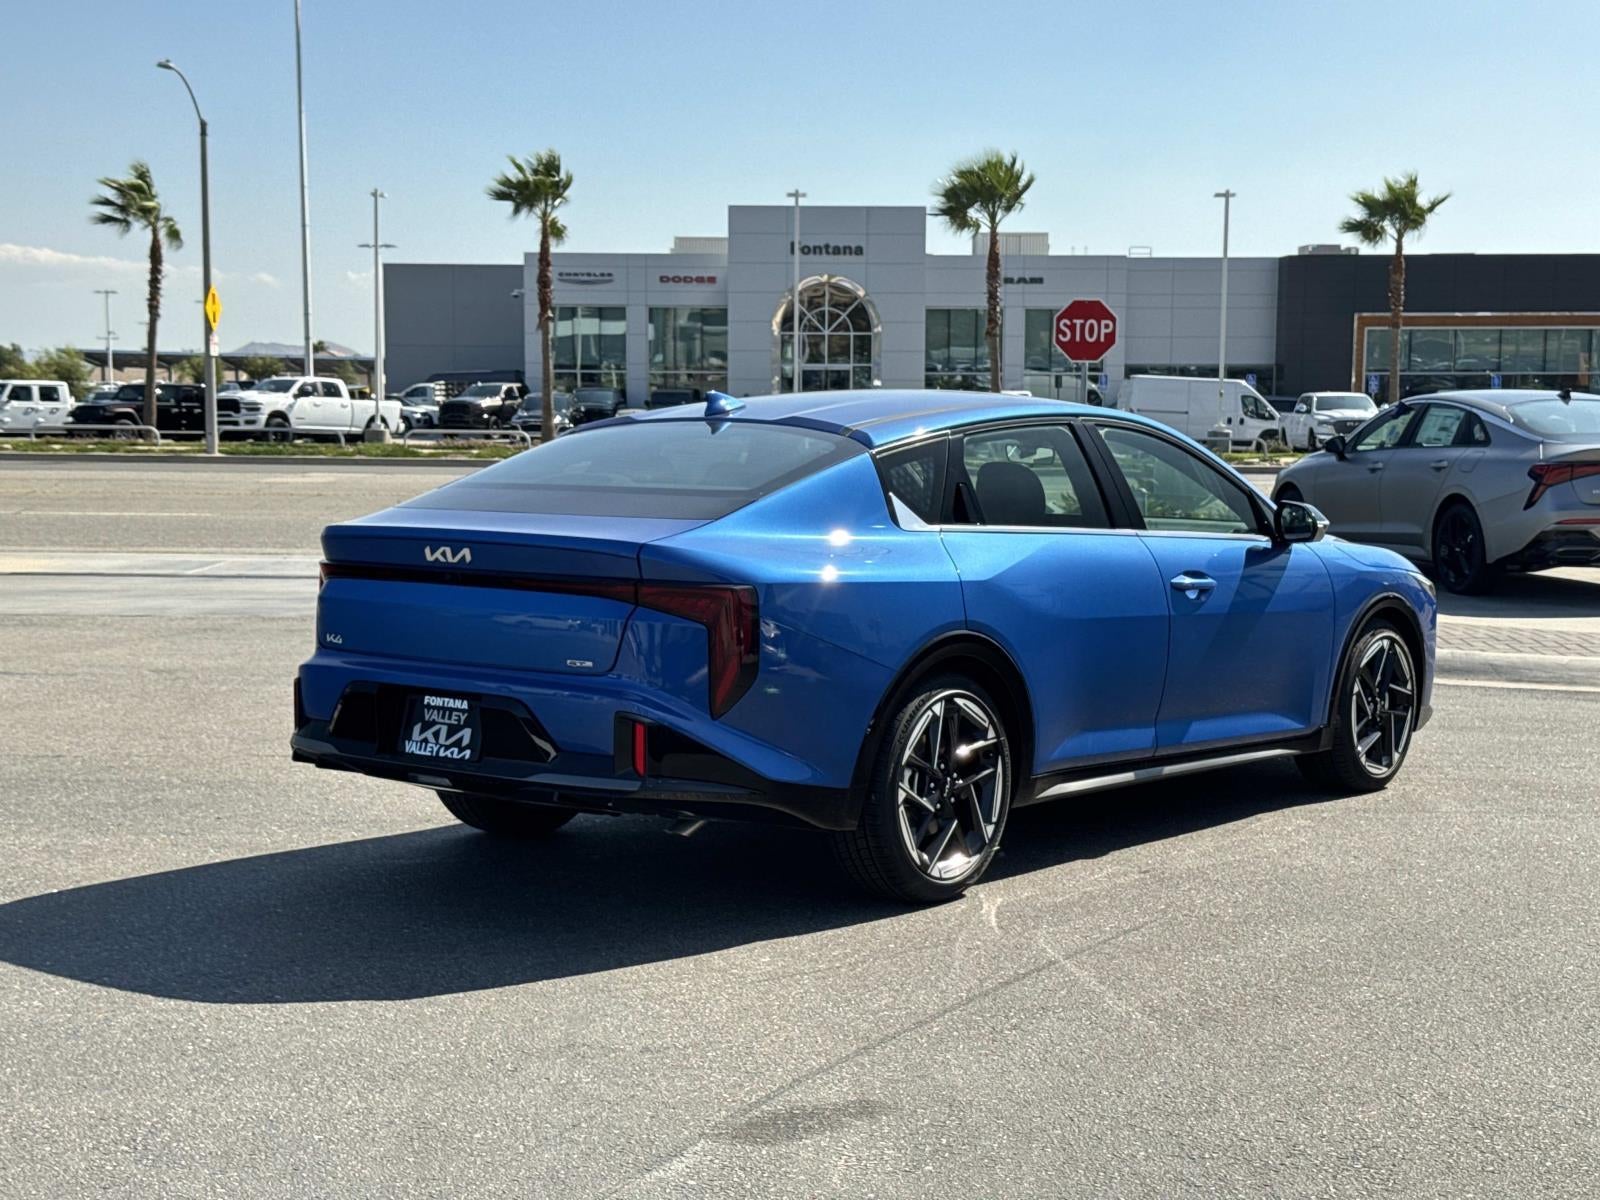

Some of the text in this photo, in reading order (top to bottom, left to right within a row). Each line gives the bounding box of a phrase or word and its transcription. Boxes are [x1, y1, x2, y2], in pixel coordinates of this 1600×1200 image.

[659, 275, 717, 284] DODGE
[1003, 277, 1044, 285] RAM
[1058, 319, 1114, 342] STOP
[424, 545, 472, 564] KIA
[326, 633, 343, 644] K4
[424, 695, 469, 710] FONTANA
[424, 708, 469, 725] VALLEY
[897, 699, 925, 745] KUMHO
[412, 722, 472, 747] KIA
[405, 740, 471, 760] VALLEY KIA
